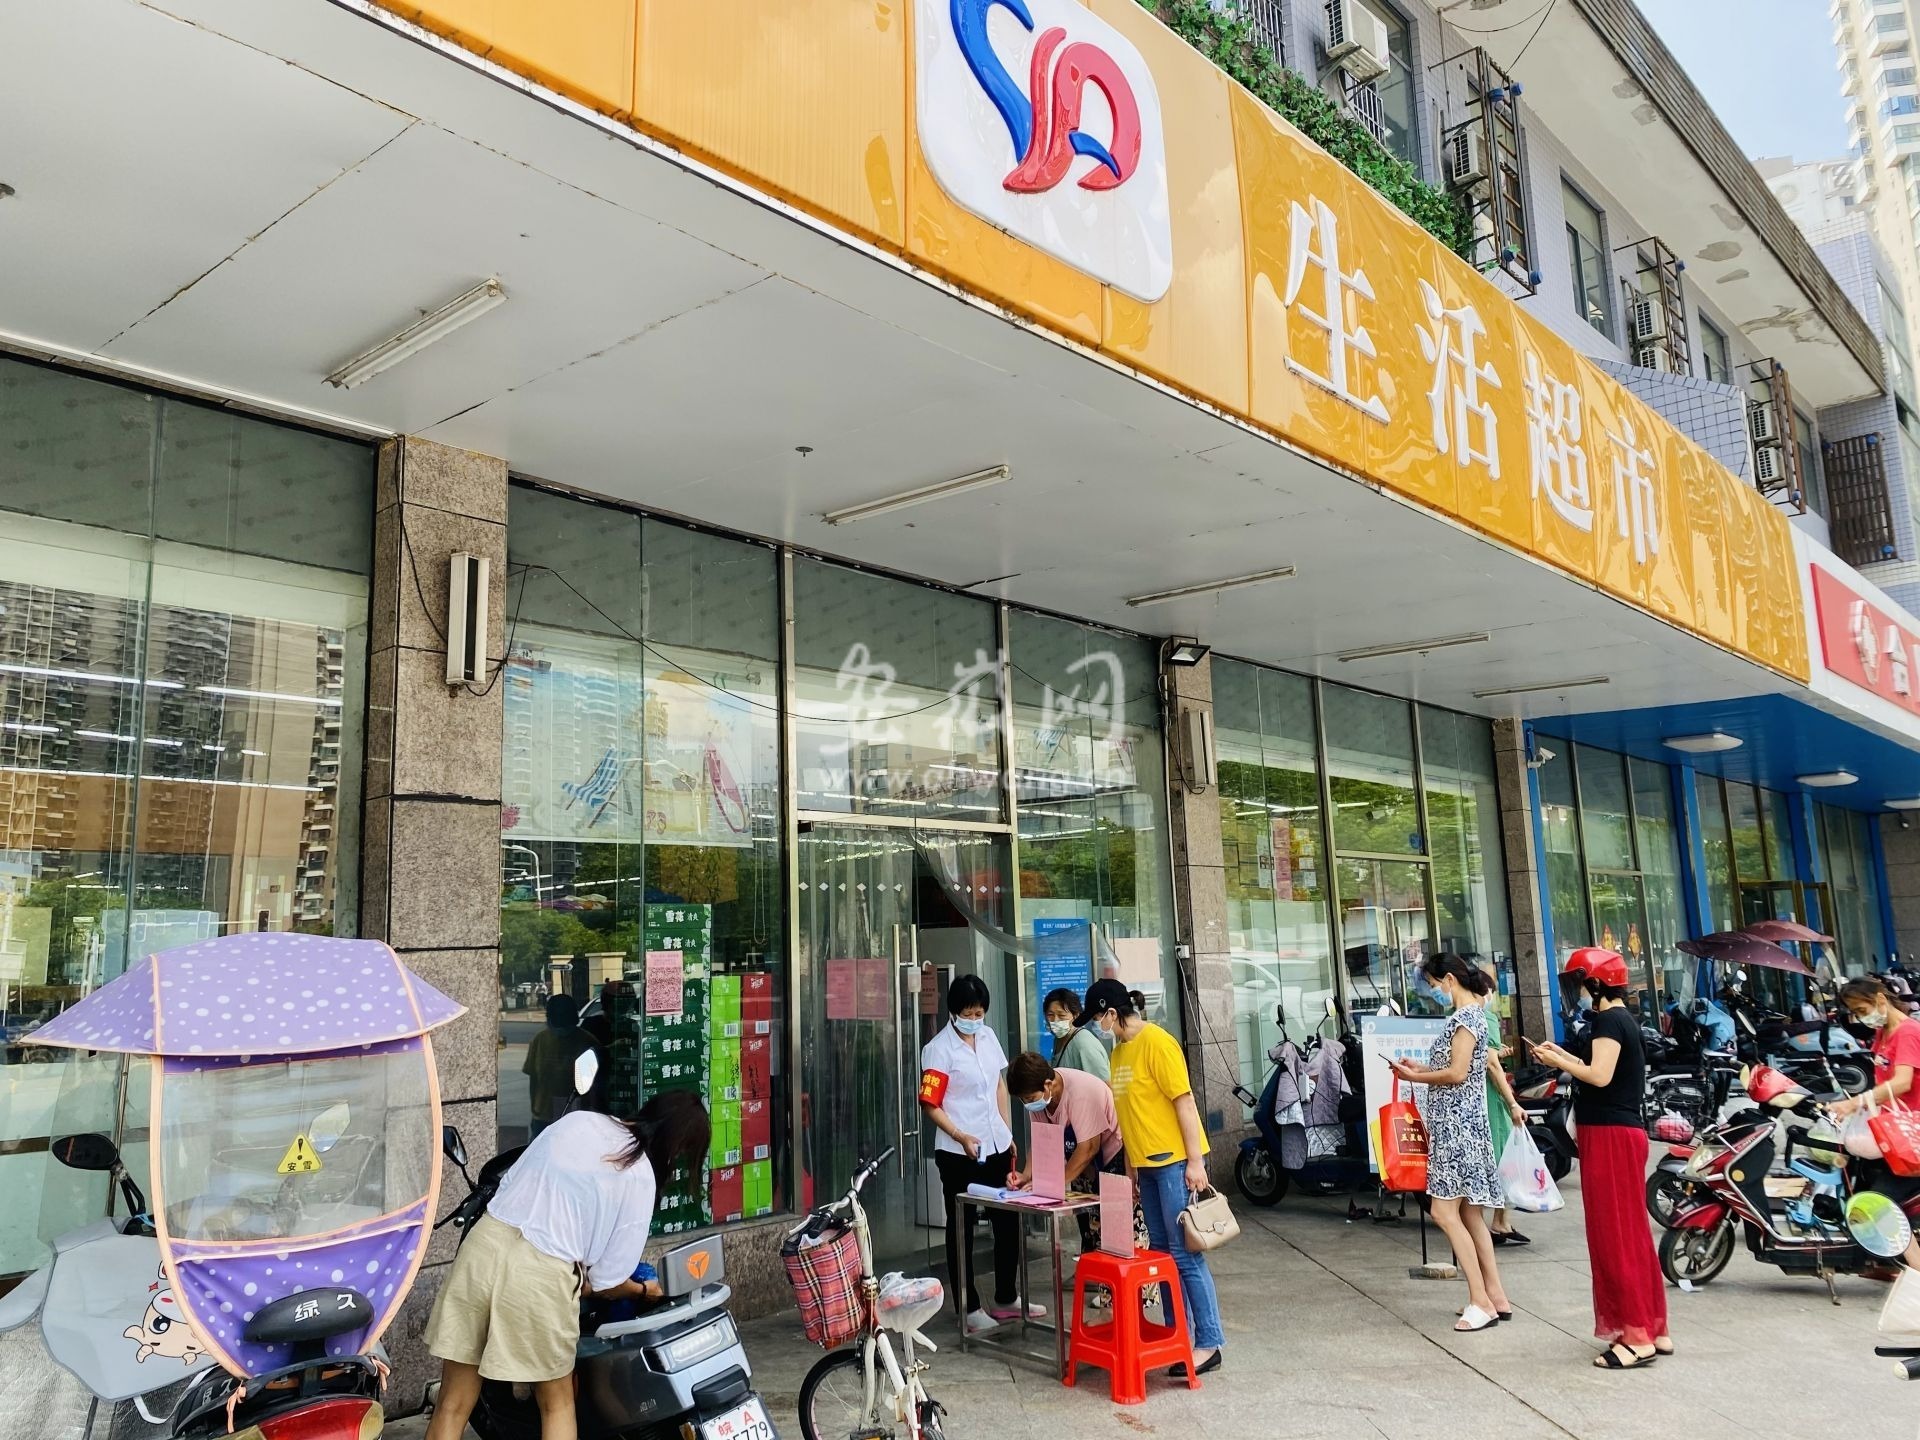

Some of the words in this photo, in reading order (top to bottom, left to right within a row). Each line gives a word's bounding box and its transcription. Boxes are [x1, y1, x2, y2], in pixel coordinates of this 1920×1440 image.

[1283, 199, 1659, 565] 生活超市
[665, 910, 685, 923] 雪花
[662, 936, 683, 949] 雪花
[662, 1038, 683, 1052] 雪花
[661, 1063, 682, 1078] 雪花
[718, 1421, 734, 1436] 皖
[743, 1411, 755, 1426] A
